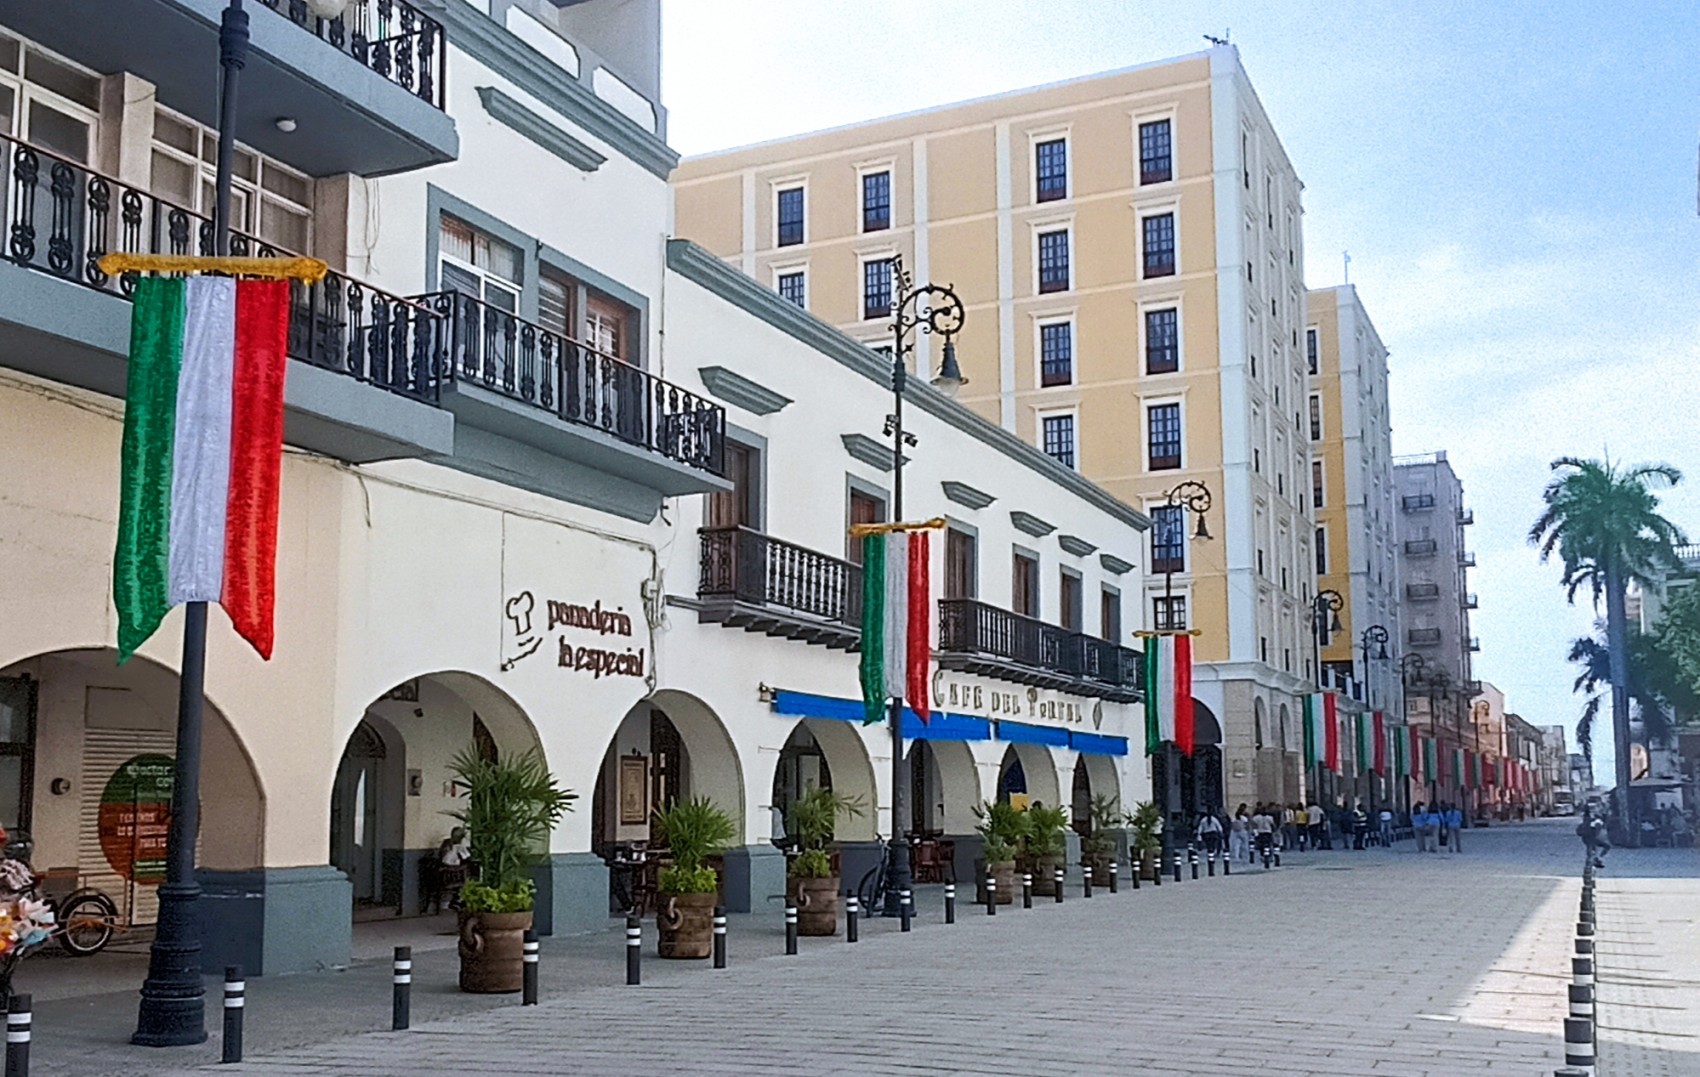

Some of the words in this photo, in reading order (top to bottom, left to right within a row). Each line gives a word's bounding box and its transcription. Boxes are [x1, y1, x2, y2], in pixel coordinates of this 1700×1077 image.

[558, 635, 574, 667] la
[574, 647, 644, 679] especial
[991, 692, 1020, 715] DEL
[1026, 687, 1082, 723] PORTAL
